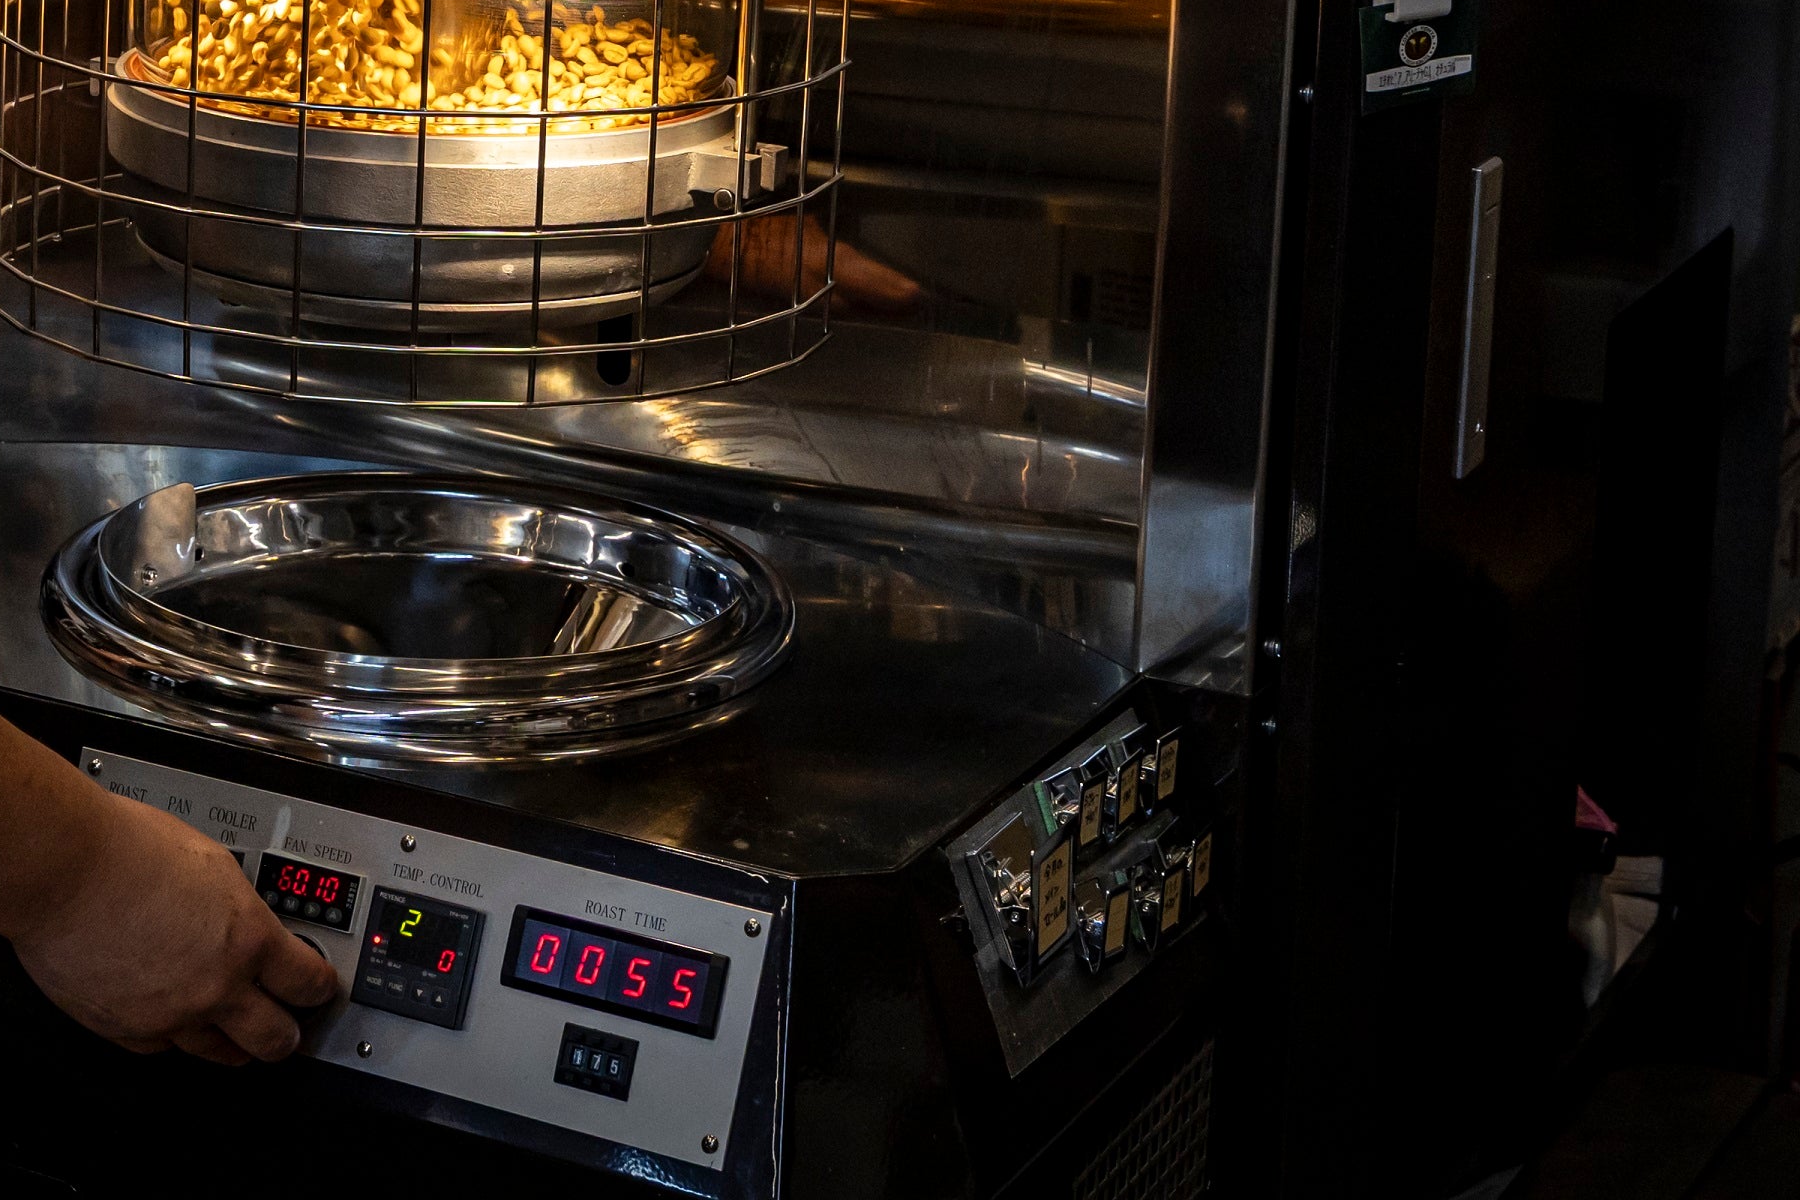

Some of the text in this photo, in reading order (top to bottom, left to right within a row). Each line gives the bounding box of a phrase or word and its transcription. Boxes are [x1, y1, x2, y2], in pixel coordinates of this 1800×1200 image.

[108, 780, 149, 803] ROAST
[208, 806, 258, 833] COOLER
[220, 828, 239, 847] ON
[284, 836, 353, 866] FAN SPEED
[393, 863, 484, 898] TEMP. CONTROL
[399, 908, 423, 938] 2
[585, 899, 668, 932] ROAST TIME
[436, 948, 457, 973] 0
[530, 933, 697, 1010] 0055
